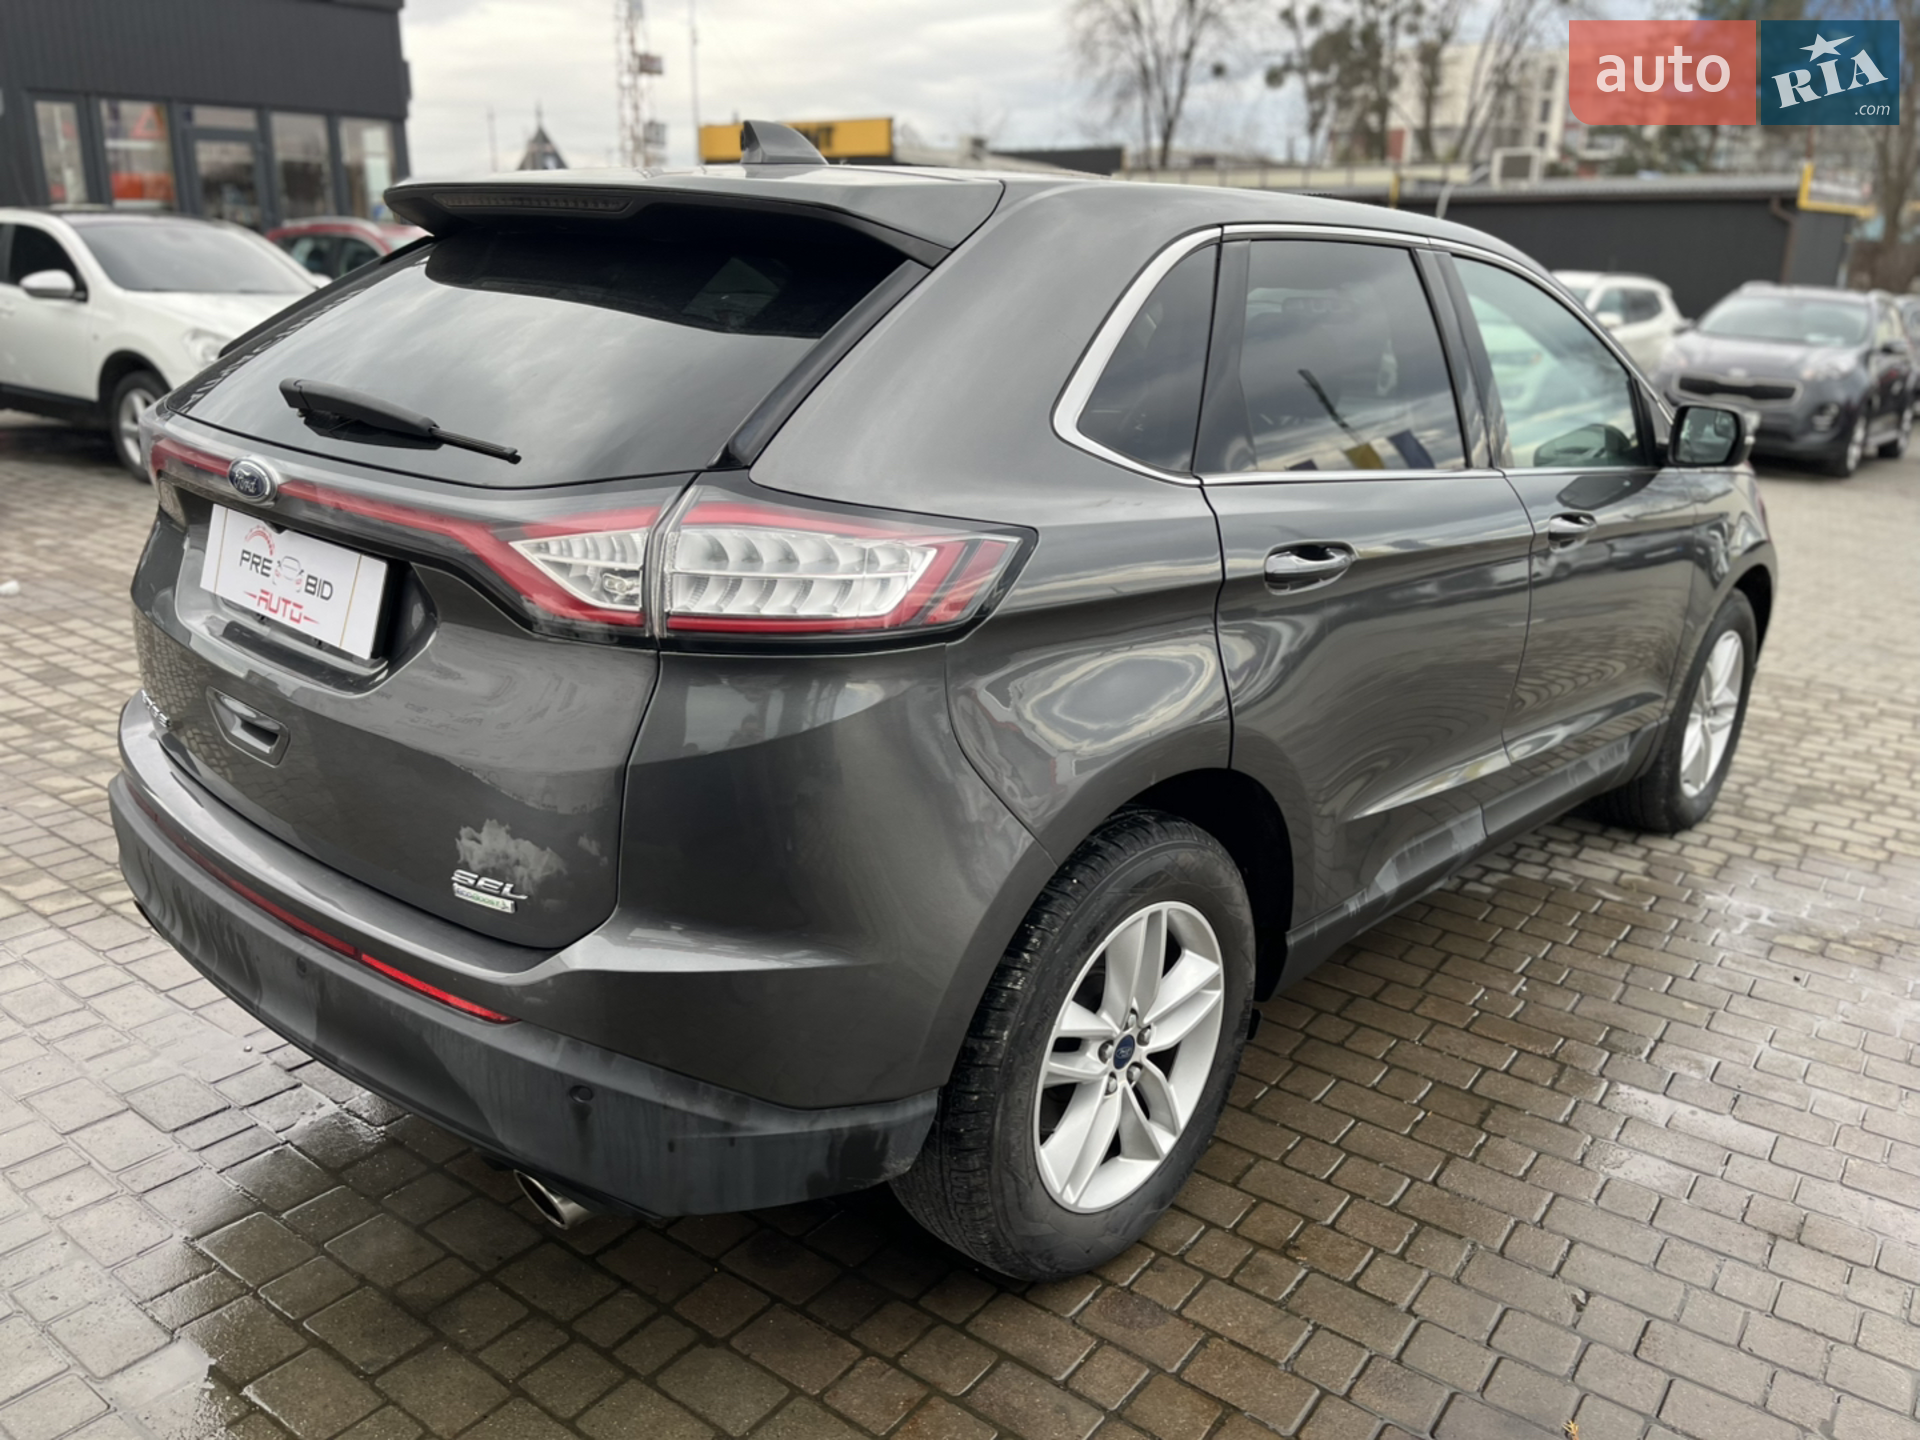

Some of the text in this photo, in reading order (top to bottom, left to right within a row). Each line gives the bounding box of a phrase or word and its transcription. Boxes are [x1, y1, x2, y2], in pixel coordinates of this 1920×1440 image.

[239, 549, 334, 601] PRE BID
[257, 588, 304, 624] AUTO
[451, 868, 528, 900] SEL
